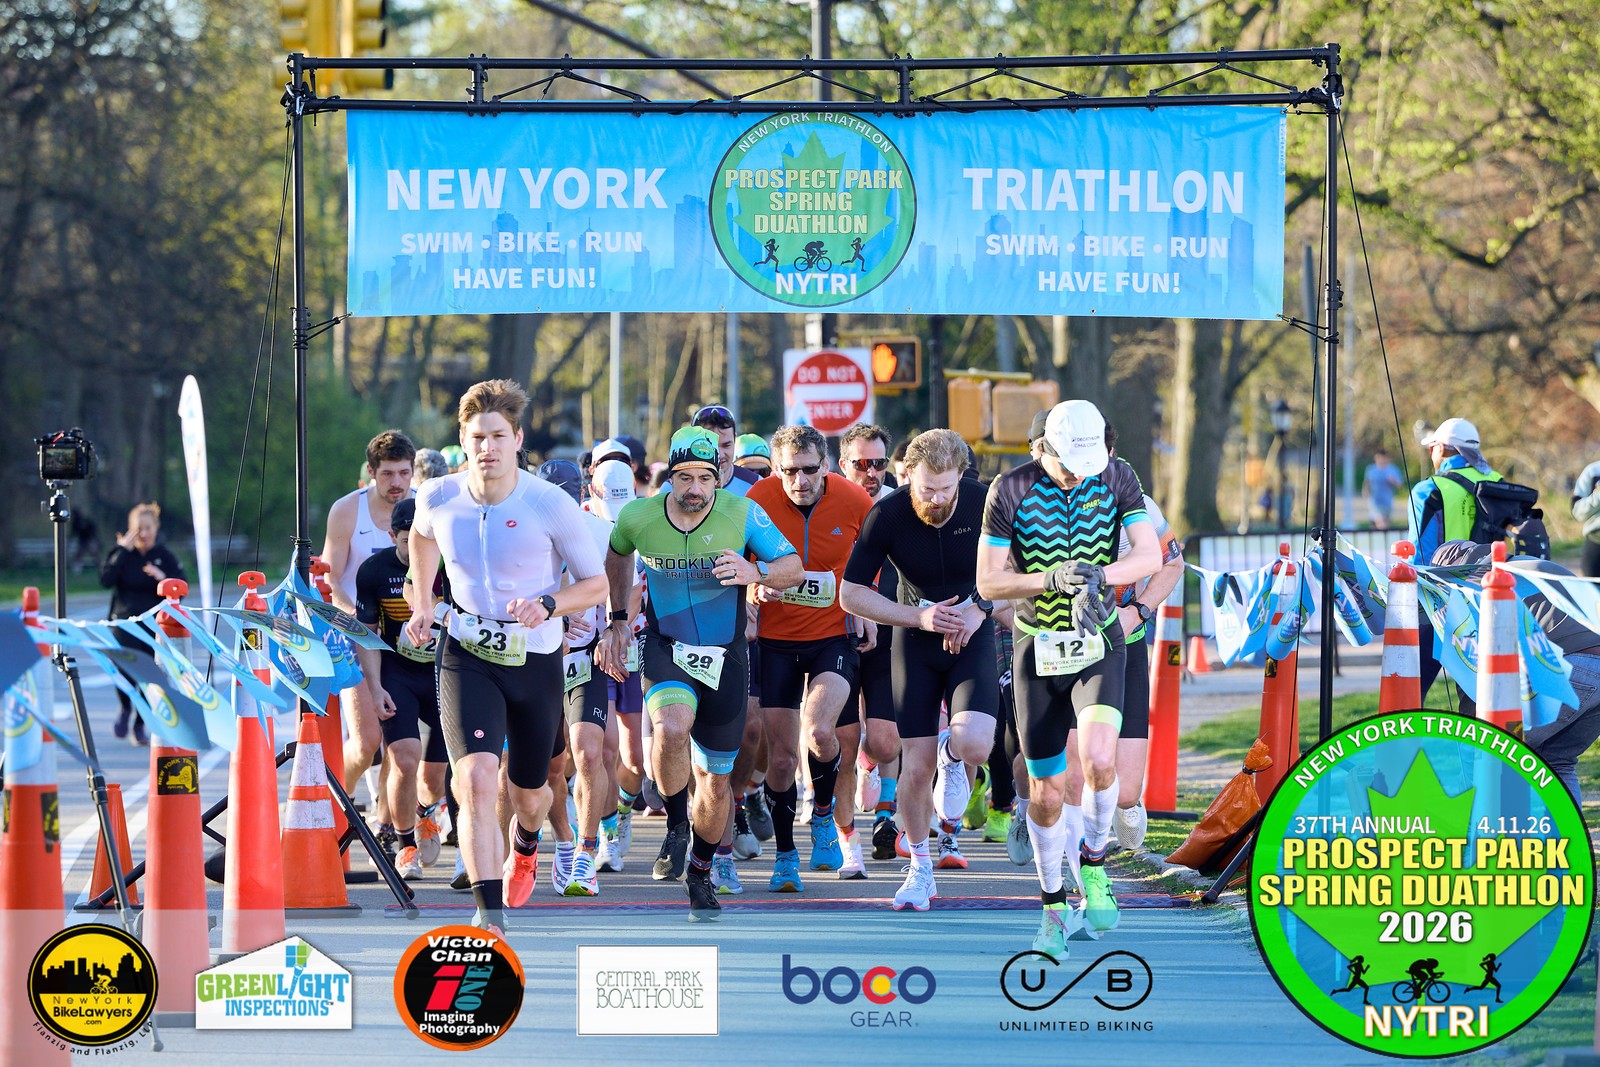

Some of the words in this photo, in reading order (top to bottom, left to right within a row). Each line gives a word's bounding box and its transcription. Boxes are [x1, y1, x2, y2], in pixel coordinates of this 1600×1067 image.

[738, 124, 769, 153] NEW
[770, 112, 810, 130] YORK
[815, 111, 893, 153] TRIATHLON
[387, 168, 506, 211] NEW
[518, 167, 668, 210] YORK
[725, 169, 840, 189] PROSPECT
[844, 169, 903, 189] PARK
[769, 191, 853, 211] SPRING
[963, 168, 1244, 214] TRIATHLON
[754, 214, 868, 234] DUATHLON
[401, 231, 472, 254] SWIM
[499, 231, 560, 253] BIKE
[585, 231, 643, 253] RUN
[986, 234, 1058, 256] SWIM
[1084, 236, 1145, 257] BIKE
[1170, 237, 1229, 259] RUN
[453, 267, 523, 289] HAVE
[531, 267, 596, 289] FUN!
[776, 273, 857, 295] NYTRI
[1038, 271, 1107, 293] HAVE
[1115, 272, 1180, 294] FUN!
[798, 365, 821, 382] DO
[827, 365, 857, 382] NOT
[645, 555, 731, 570] BROOKLY
[665, 571, 680, 579] TRI
[478, 629, 507, 652] 23
[1055, 640, 1084, 658] 12
[687, 652, 714, 670] 29
[163, 758, 180, 769] YORK
